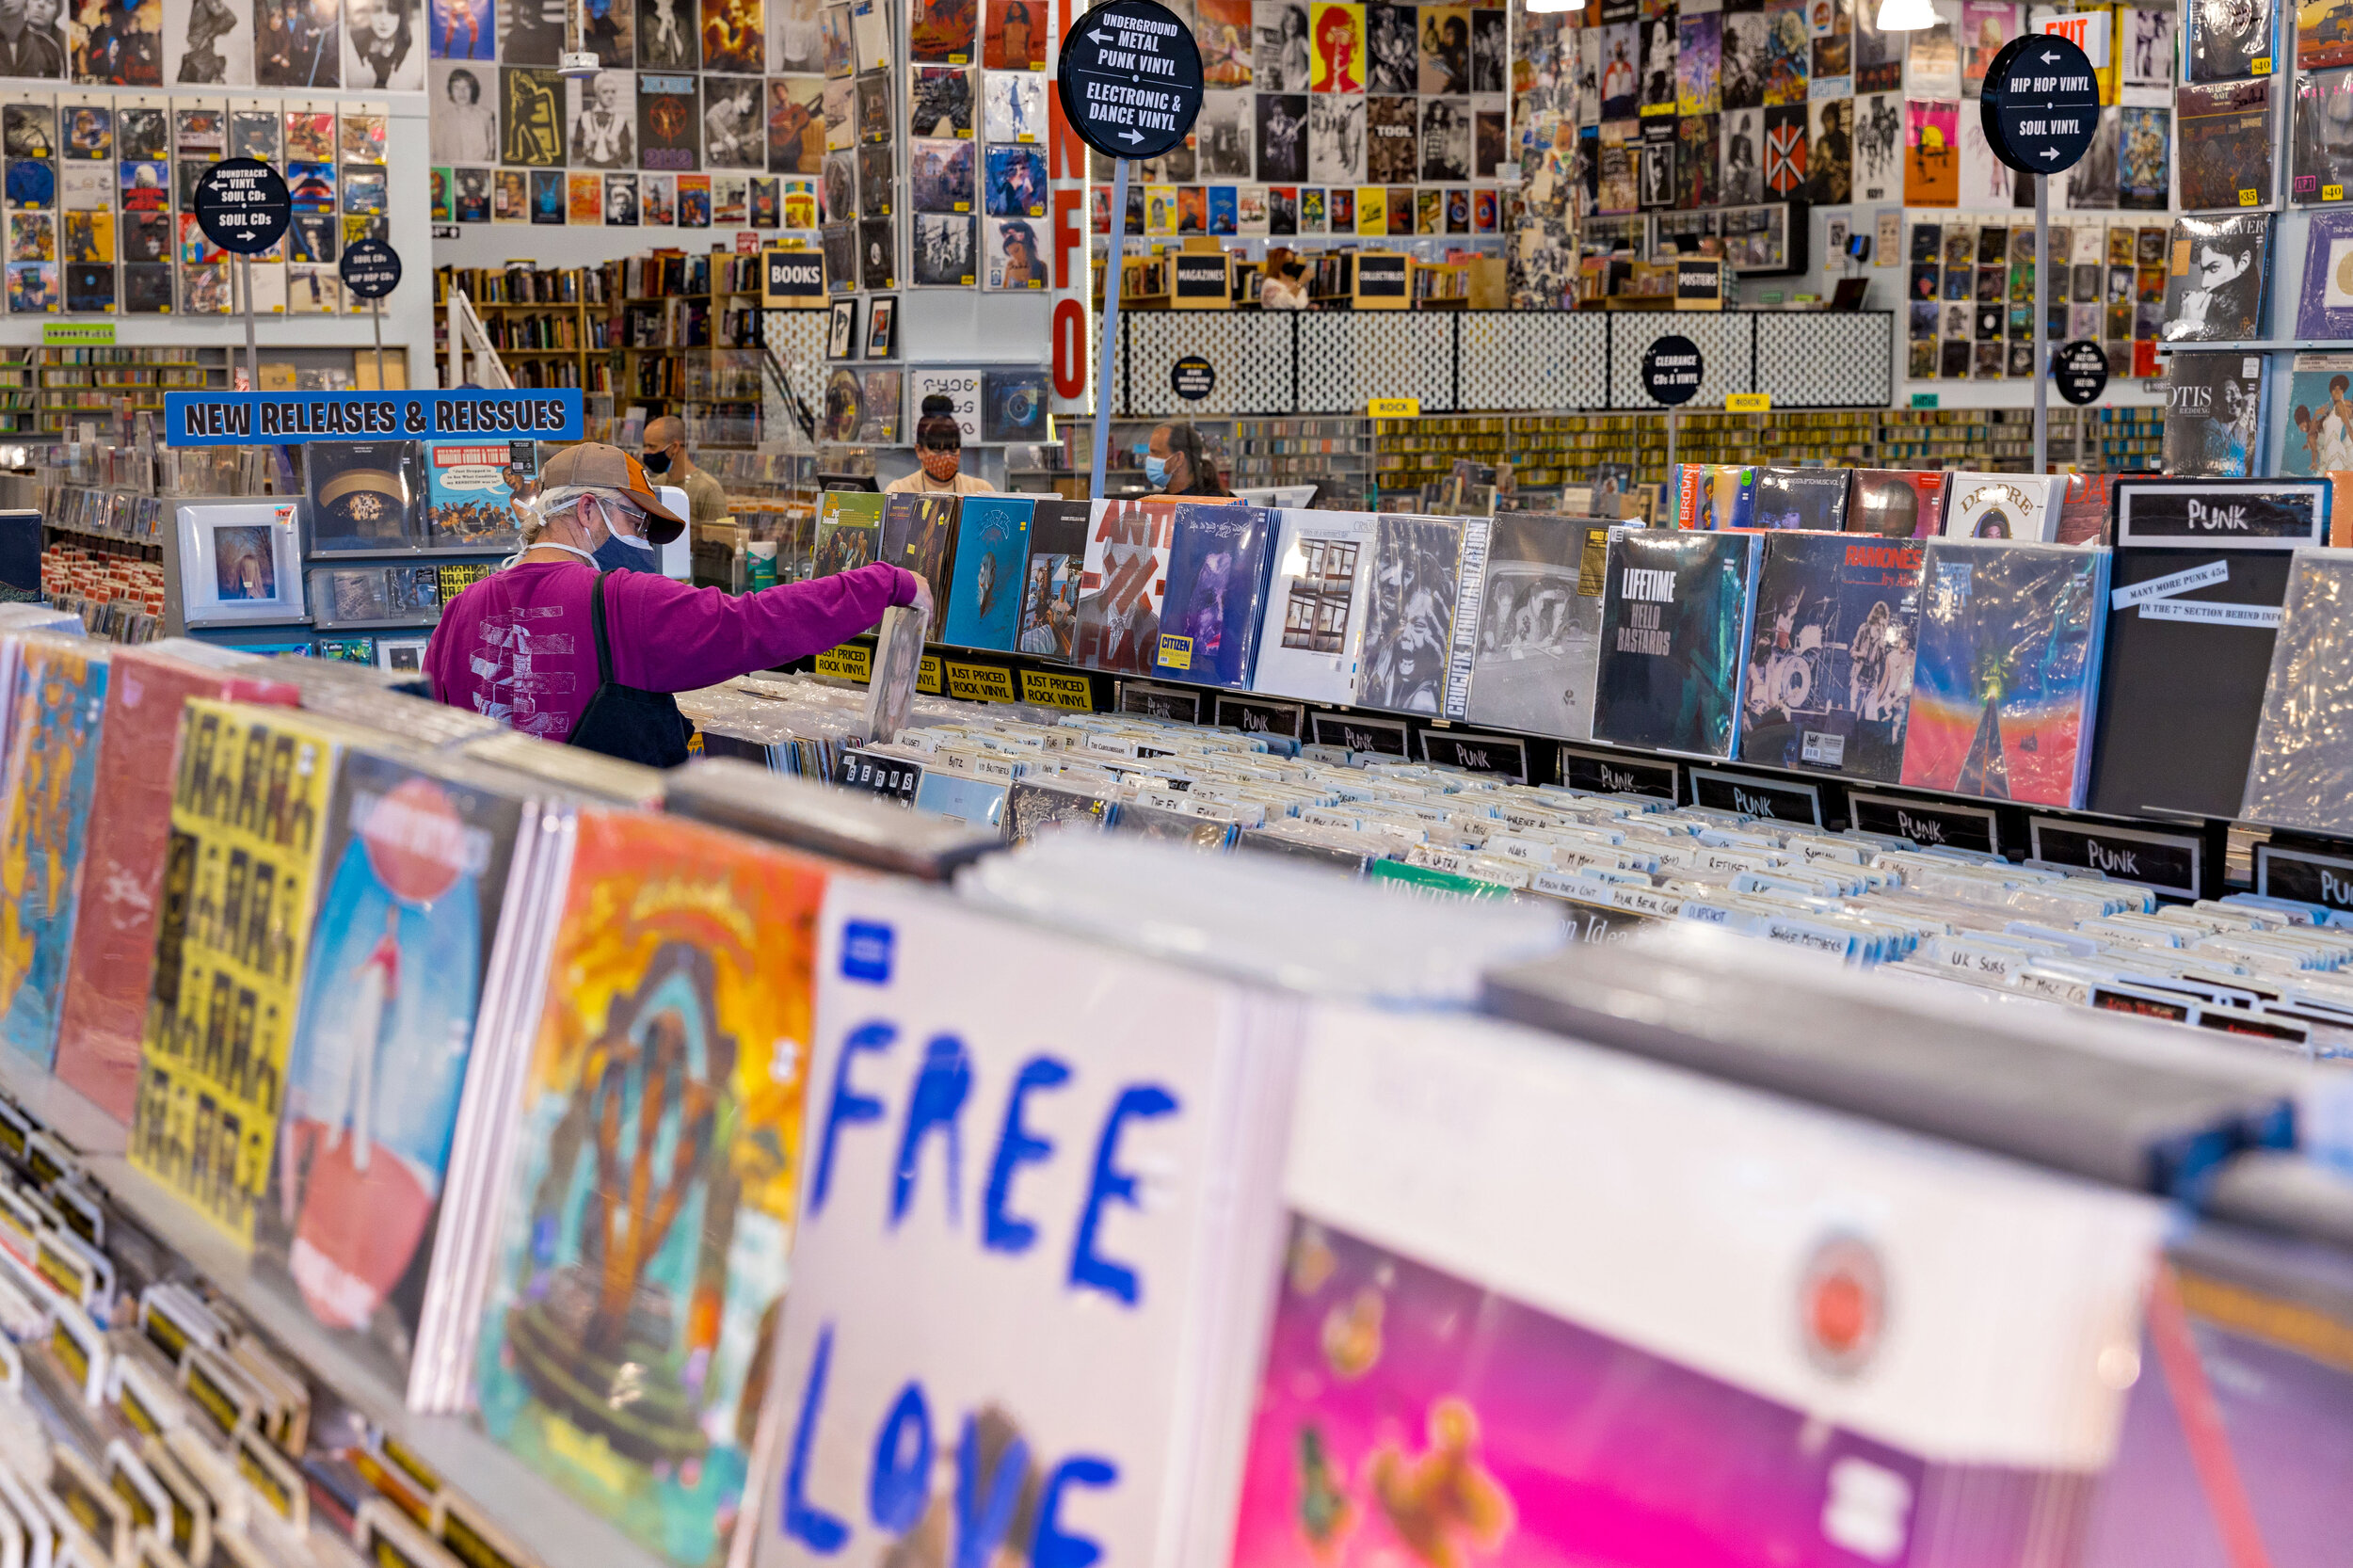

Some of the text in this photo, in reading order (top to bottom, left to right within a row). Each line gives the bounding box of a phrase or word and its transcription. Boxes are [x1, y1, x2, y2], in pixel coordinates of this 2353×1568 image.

[1103, 13, 1178, 38] UNDERGROUND
[1118, 30, 1159, 52] METAL
[1097, 49, 1176, 76] PUNK VINYL
[2010, 76, 2089, 93] HIP HOP VINYL
[1086, 81, 1181, 113] ELECTRONIC &
[1089, 103, 1176, 132] DANCE VINYL
[2019, 119, 2080, 136] SOUL VINYL
[1375, 125, 1413, 137] TOOL
[216, 168, 267, 179] SOUNDTRACKS
[230, 178, 256, 189] VINYL
[221, 190, 266, 202] SOUL CDs
[219, 214, 272, 227] SOUL CDs
[353, 254, 371, 264] SOUL
[771, 265, 821, 284] BOOKS
[1177, 269, 1225, 282] MAGAZINES
[1678, 272, 1719, 287] POSTERS
[1655, 355, 1698, 367] CLEARANCE
[1676, 373, 1699, 385] VINYL
[185, 398, 567, 437] NEW RELEASES & REISSUES
[1379, 402, 1409, 412] ROCK
[2187, 498, 2249, 531] PUNK
[1845, 545, 1923, 569] RAMONES
[1622, 568, 1677, 602] LIFETIME
[2130, 567, 2226, 600] MANY MORE PUNK 45s
[1630, 603, 1661, 631] HELLO
[2141, 603, 2151, 613] IN
[2153, 603, 2170, 614] THE
[2184, 607, 2222, 618] SECTION
[2225, 609, 2260, 621] BEHIND
[1161, 636, 1191, 652] CITIZEN
[1617, 627, 1672, 656] BASTARDS
[837, 648, 866, 663] PRICED
[819, 659, 866, 677] ROCK VINYL
[952, 667, 1006, 684] JUST PRICED
[953, 681, 1010, 699] ROCK VINYL
[1027, 676, 1084, 693] JUST PRICED
[1447, 650, 1472, 716] CRUCIFIX
[1029, 691, 1087, 709] ROCK VINYL
[1147, 696, 1172, 719] PUNK
[1243, 708, 1269, 732] PUNK
[1344, 726, 1375, 752] PUNK
[1456, 743, 1491, 768] PUNK
[846, 764, 913, 790] GERMS
[1600, 763, 1636, 792] PUNK
[1734, 787, 1776, 818] PUNK
[1897, 810, 1945, 843] PUNK
[2087, 839, 2140, 875] PUNK
[1951, 951, 1969, 968] UK
[805, 1016, 1184, 1310] FREE
[780, 1319, 1122, 1568] LOVE
